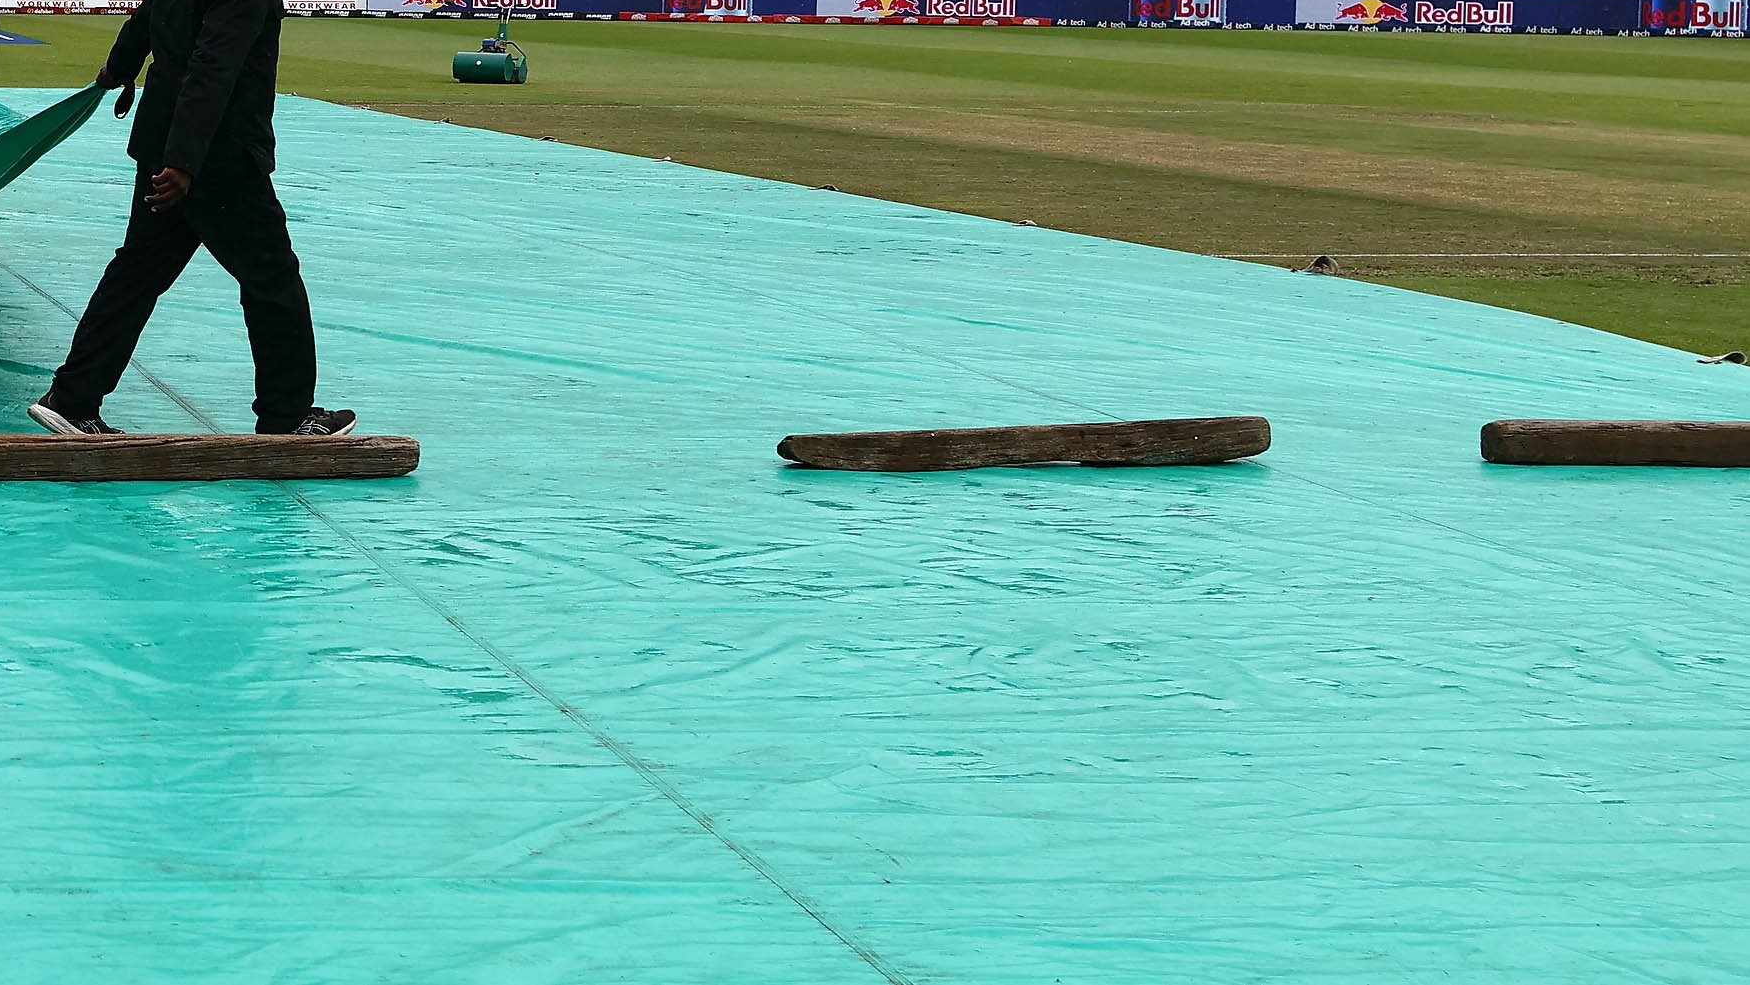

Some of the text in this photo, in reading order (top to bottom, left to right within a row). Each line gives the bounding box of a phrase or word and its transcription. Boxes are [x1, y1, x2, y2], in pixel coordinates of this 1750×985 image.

[1415, 1, 1513, 25] Red Bull
[1691, 2, 1740, 27] Bull
